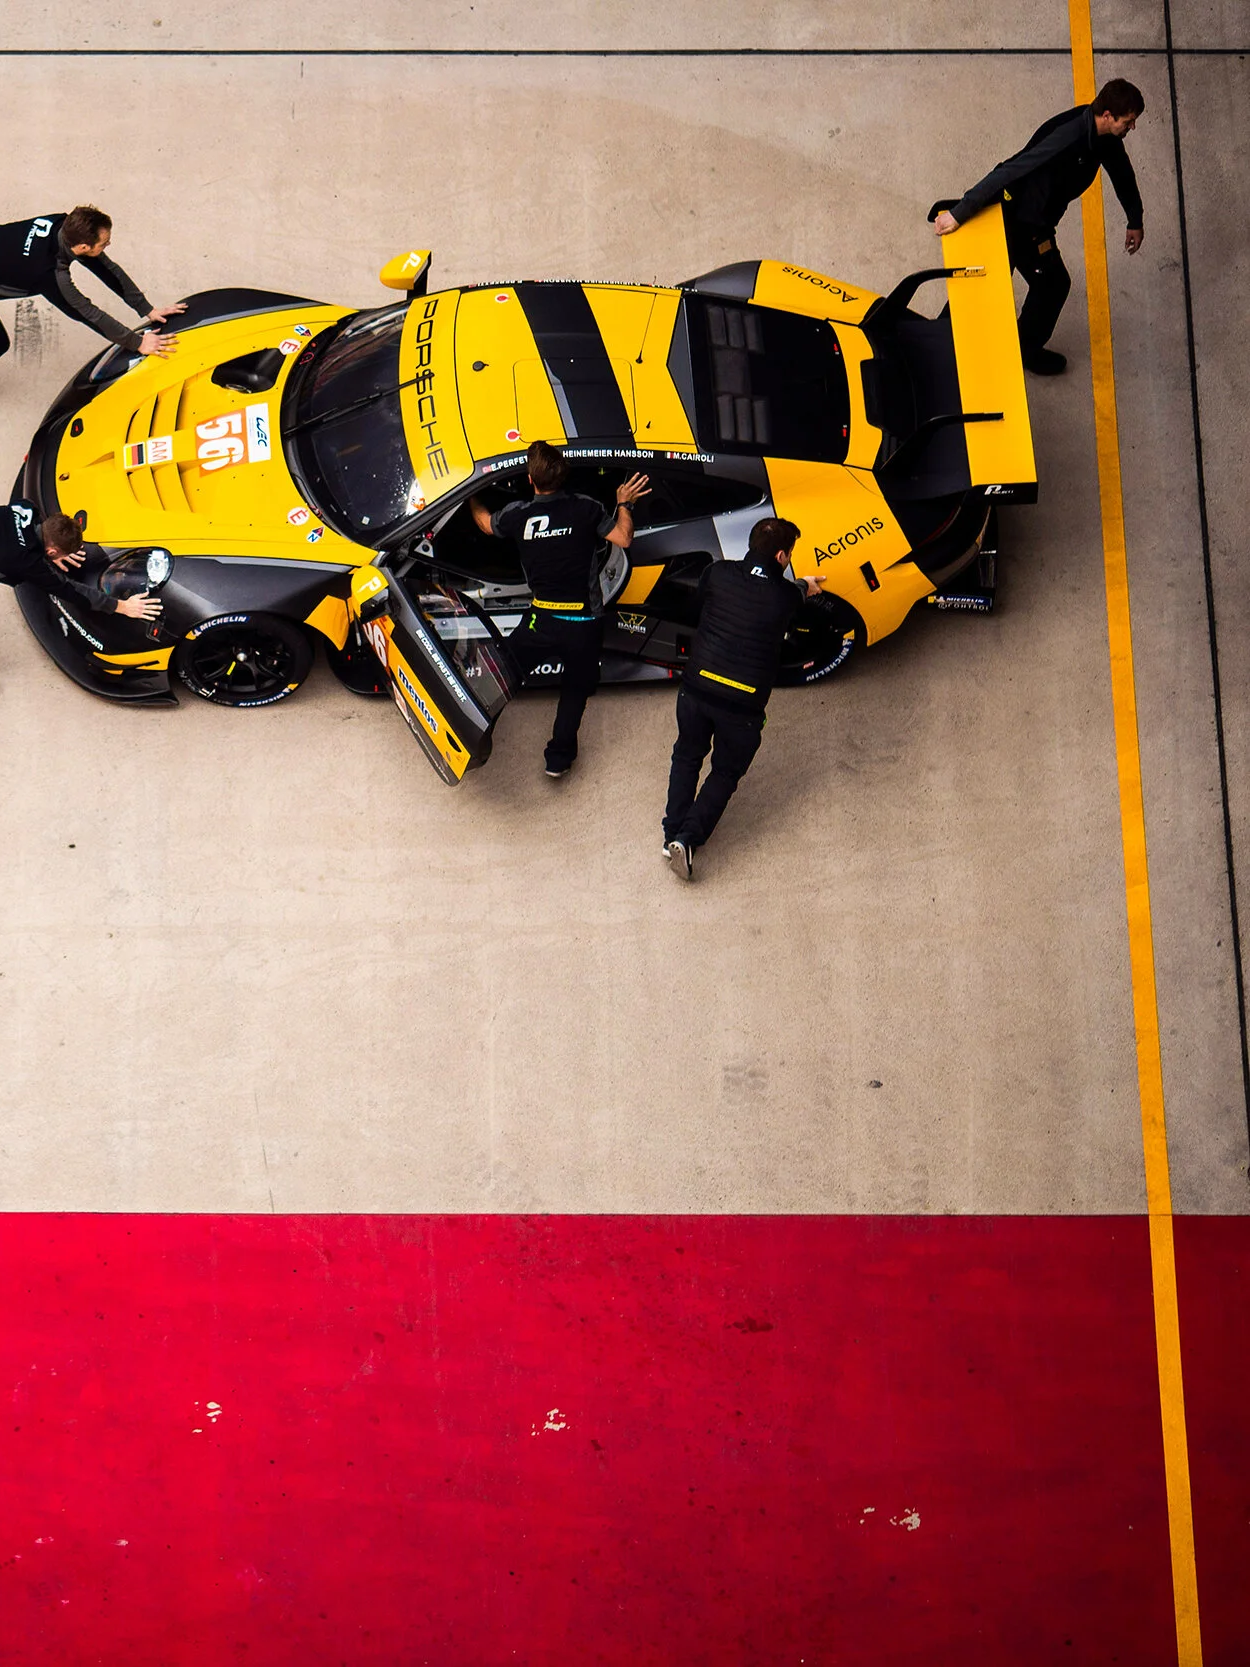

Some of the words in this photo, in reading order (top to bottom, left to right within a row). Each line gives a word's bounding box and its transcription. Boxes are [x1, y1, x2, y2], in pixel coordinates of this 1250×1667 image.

[782, 266, 859, 303] Acronis
[415, 299, 450, 481] PORSCHE
[196, 412, 245, 471] 56
[255, 416, 268, 447] WEC
[152, 441, 167, 462] AM
[490, 455, 528, 472] E.PERFET
[562, 449, 613, 458] HEINEMEIER
[614, 449, 654, 459] HANSSON
[673, 452, 715, 463] M.CAIROLI
[534, 527, 568, 539] PROJECT
[814, 517, 884, 567] Acronis
[199, 615, 247, 632] MICHELIN
[806, 647, 850, 681] MICHELIN
[398, 667, 438, 733] mentos
